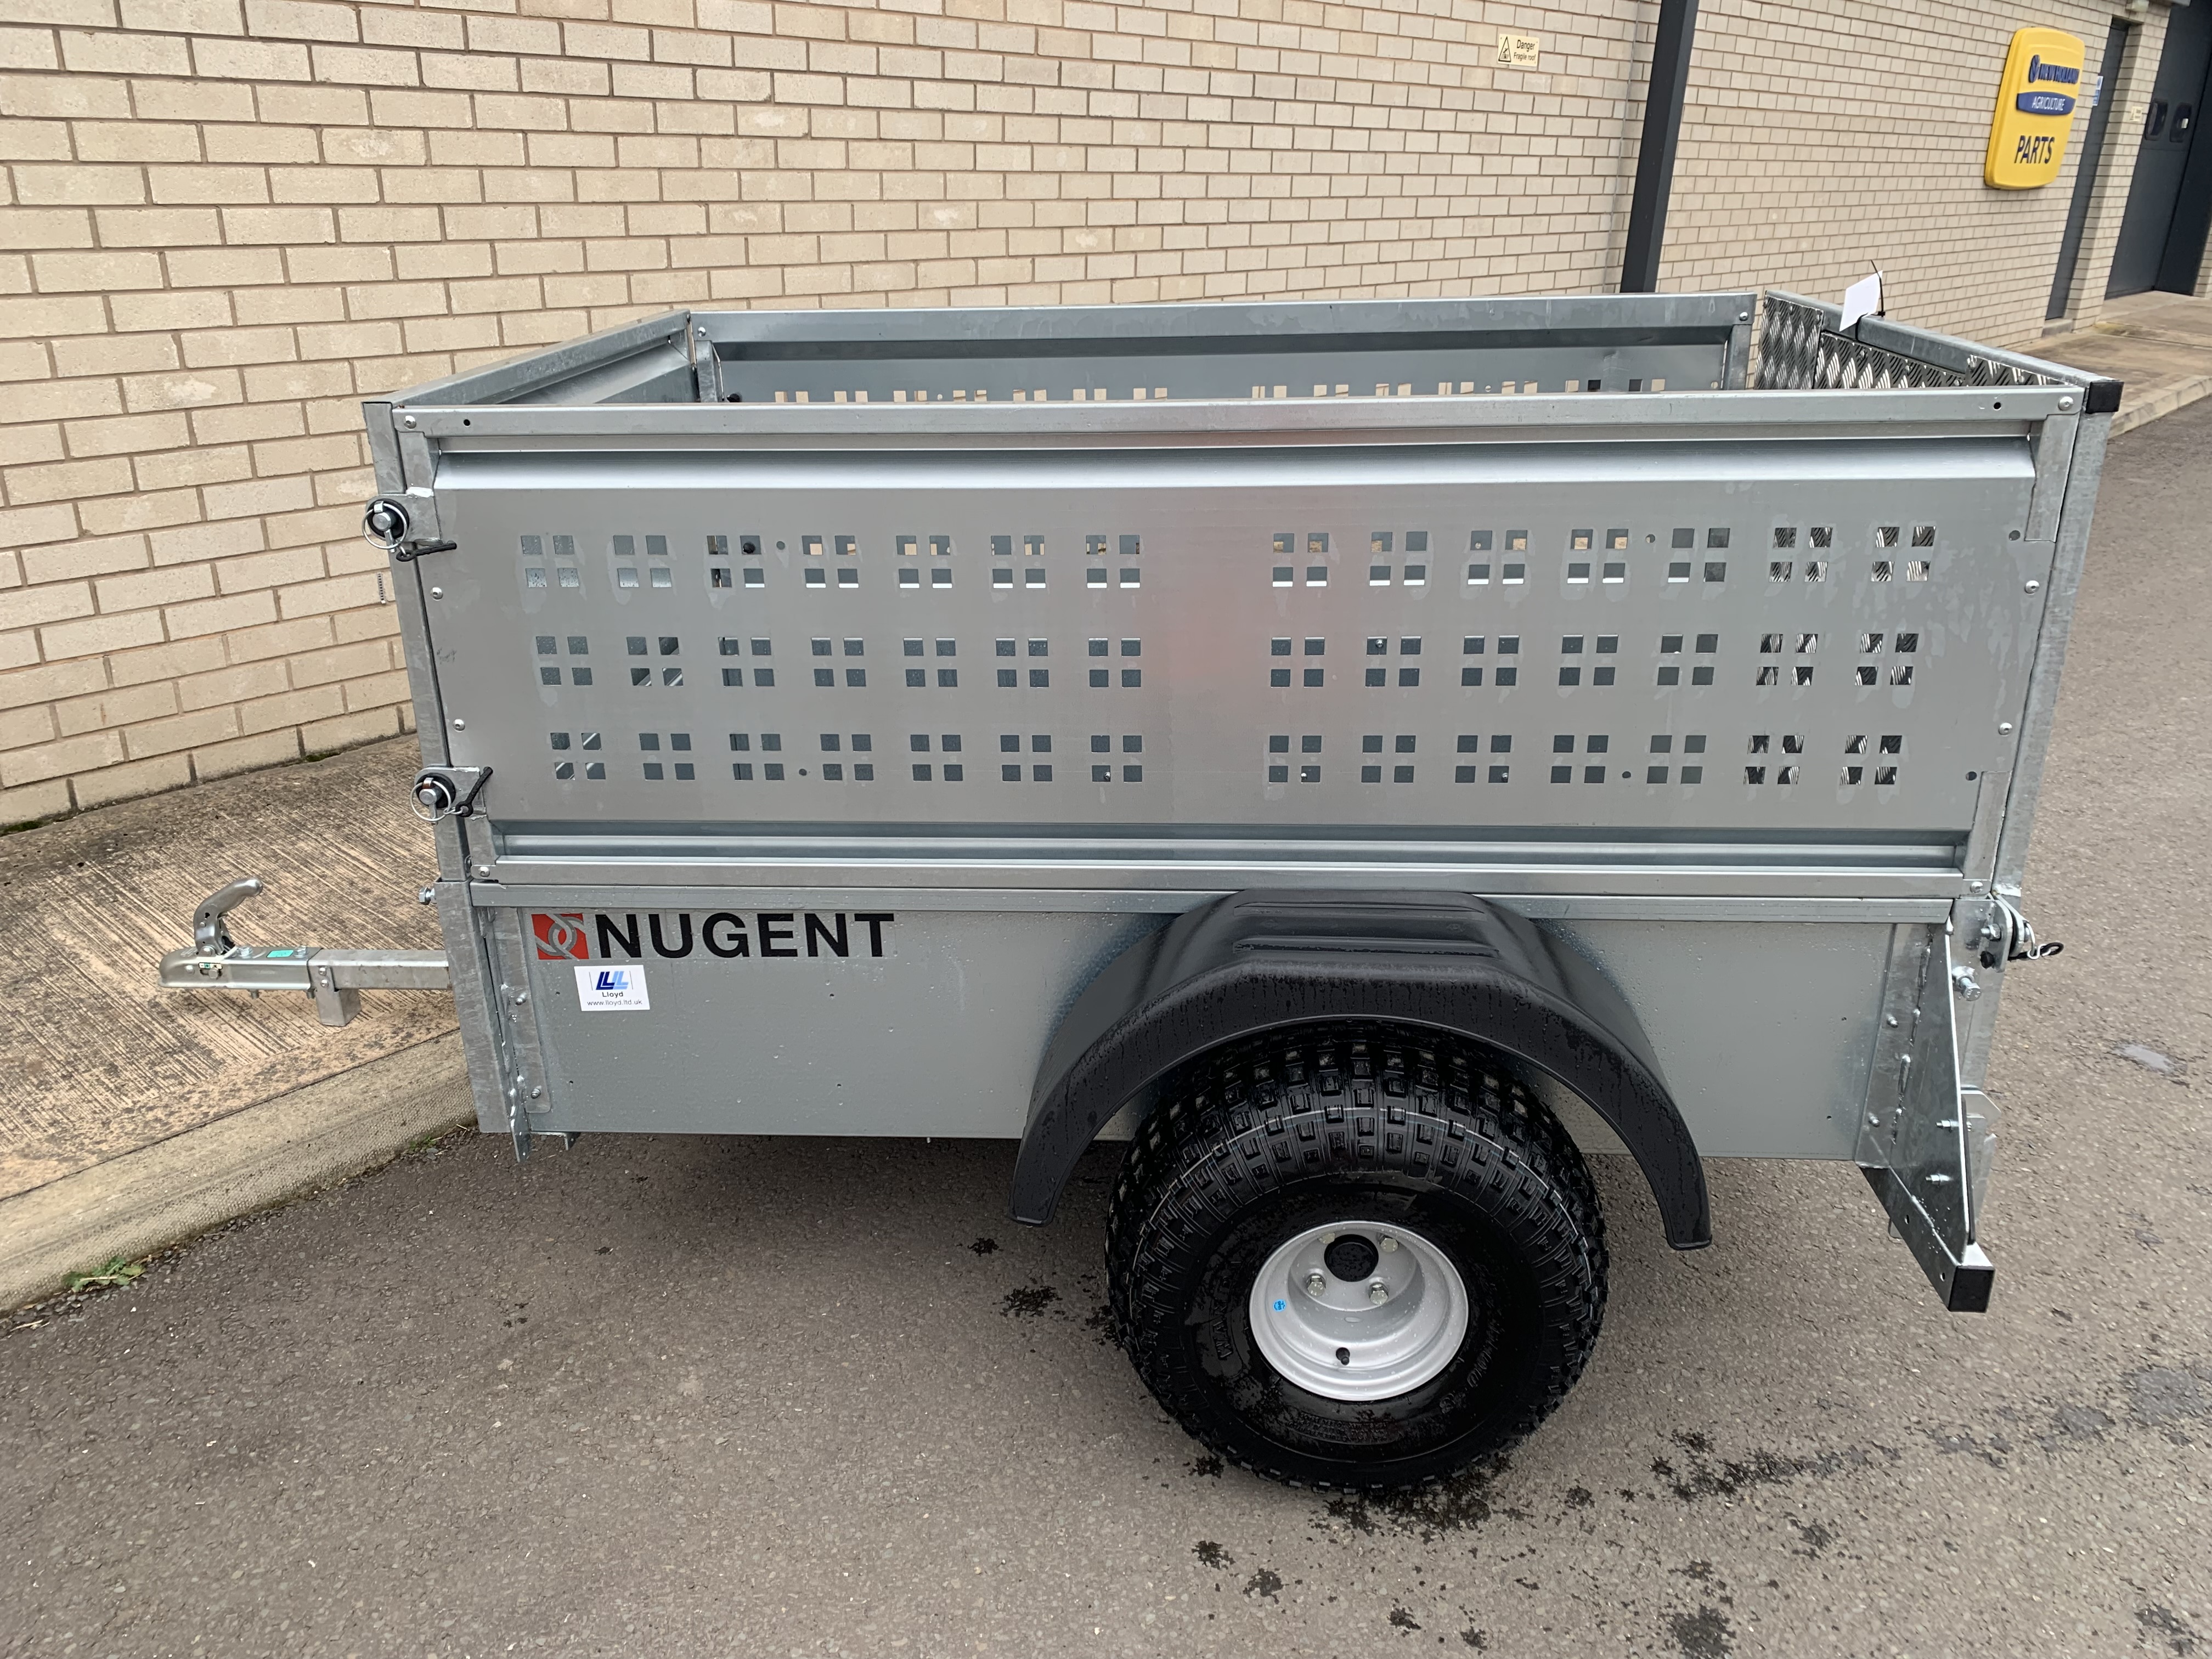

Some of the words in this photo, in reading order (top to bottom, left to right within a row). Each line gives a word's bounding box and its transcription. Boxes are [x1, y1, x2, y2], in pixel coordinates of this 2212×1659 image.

[1516, 40, 1535, 52] Danger
[1514, 52, 1527, 61] Fragile
[2032, 96, 2066, 111] AGRICULTURE
[2014, 135, 2055, 164] PARTS
[594, 912, 895, 959] NUGENT
